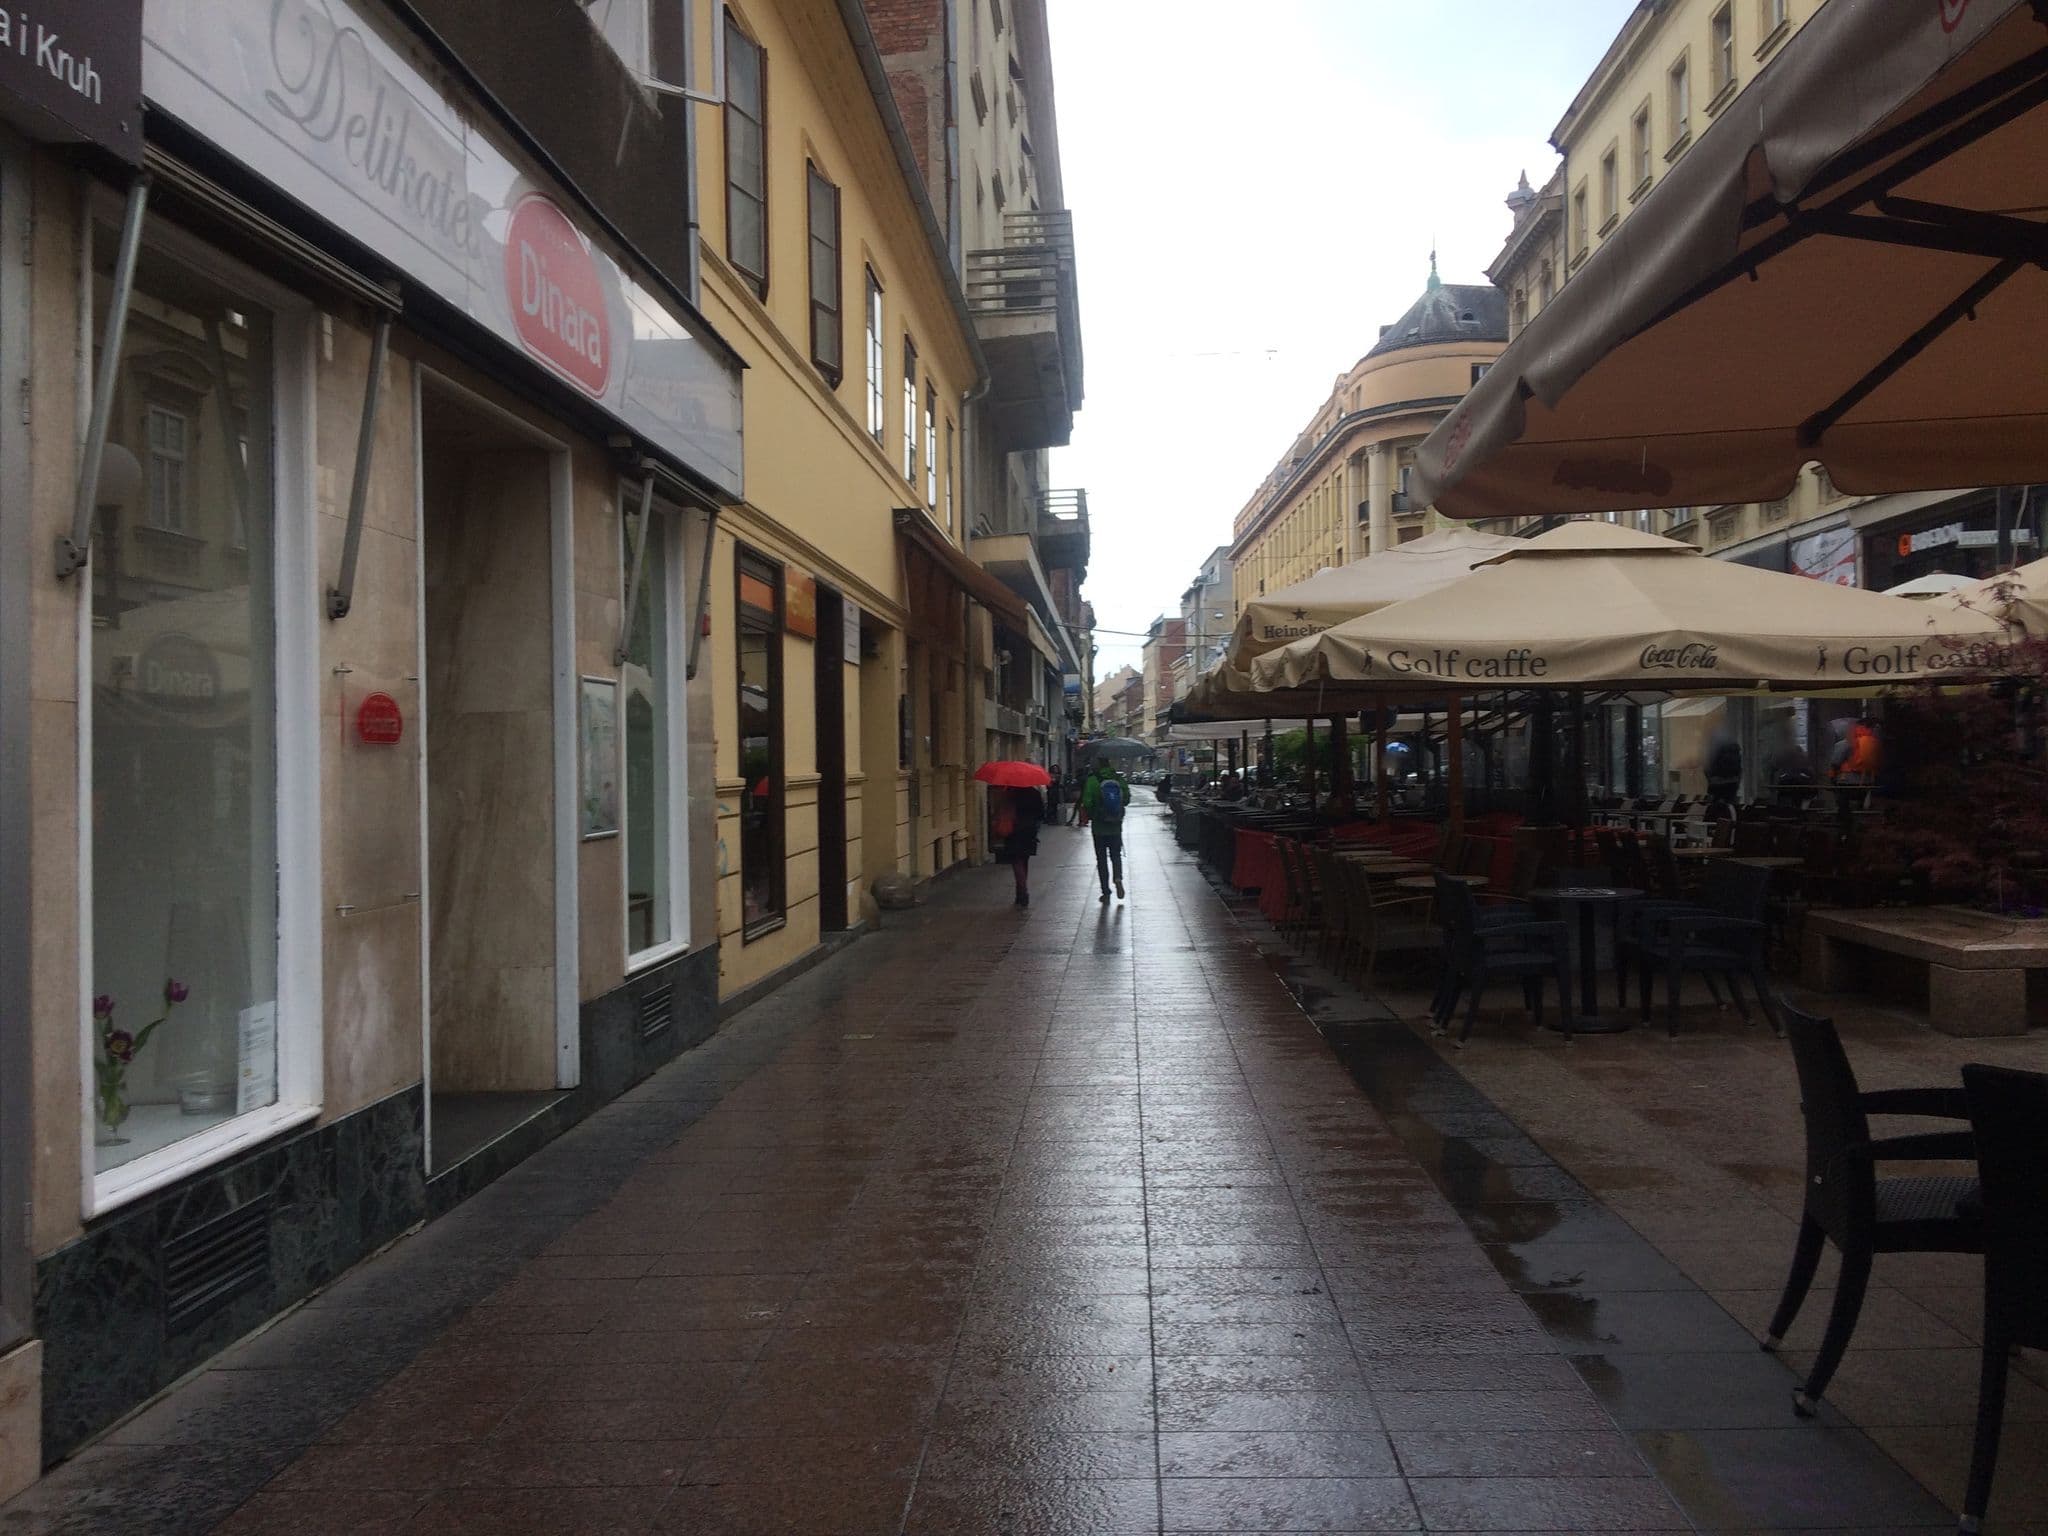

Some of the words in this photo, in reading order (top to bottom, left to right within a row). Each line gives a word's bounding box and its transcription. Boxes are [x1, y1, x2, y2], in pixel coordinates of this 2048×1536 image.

[20, 13, 28, 56] i
[37, 24, 102, 104] Kruh
[520, 239, 602, 369] Dinara
[1264, 622, 1336, 639] Heineke
[1387, 649, 1461, 678] Golf
[1465, 648, 1548, 678] caffe
[1639, 643, 1719, 669] Coca-Cola
[1843, 645, 1921, 675] Golf
